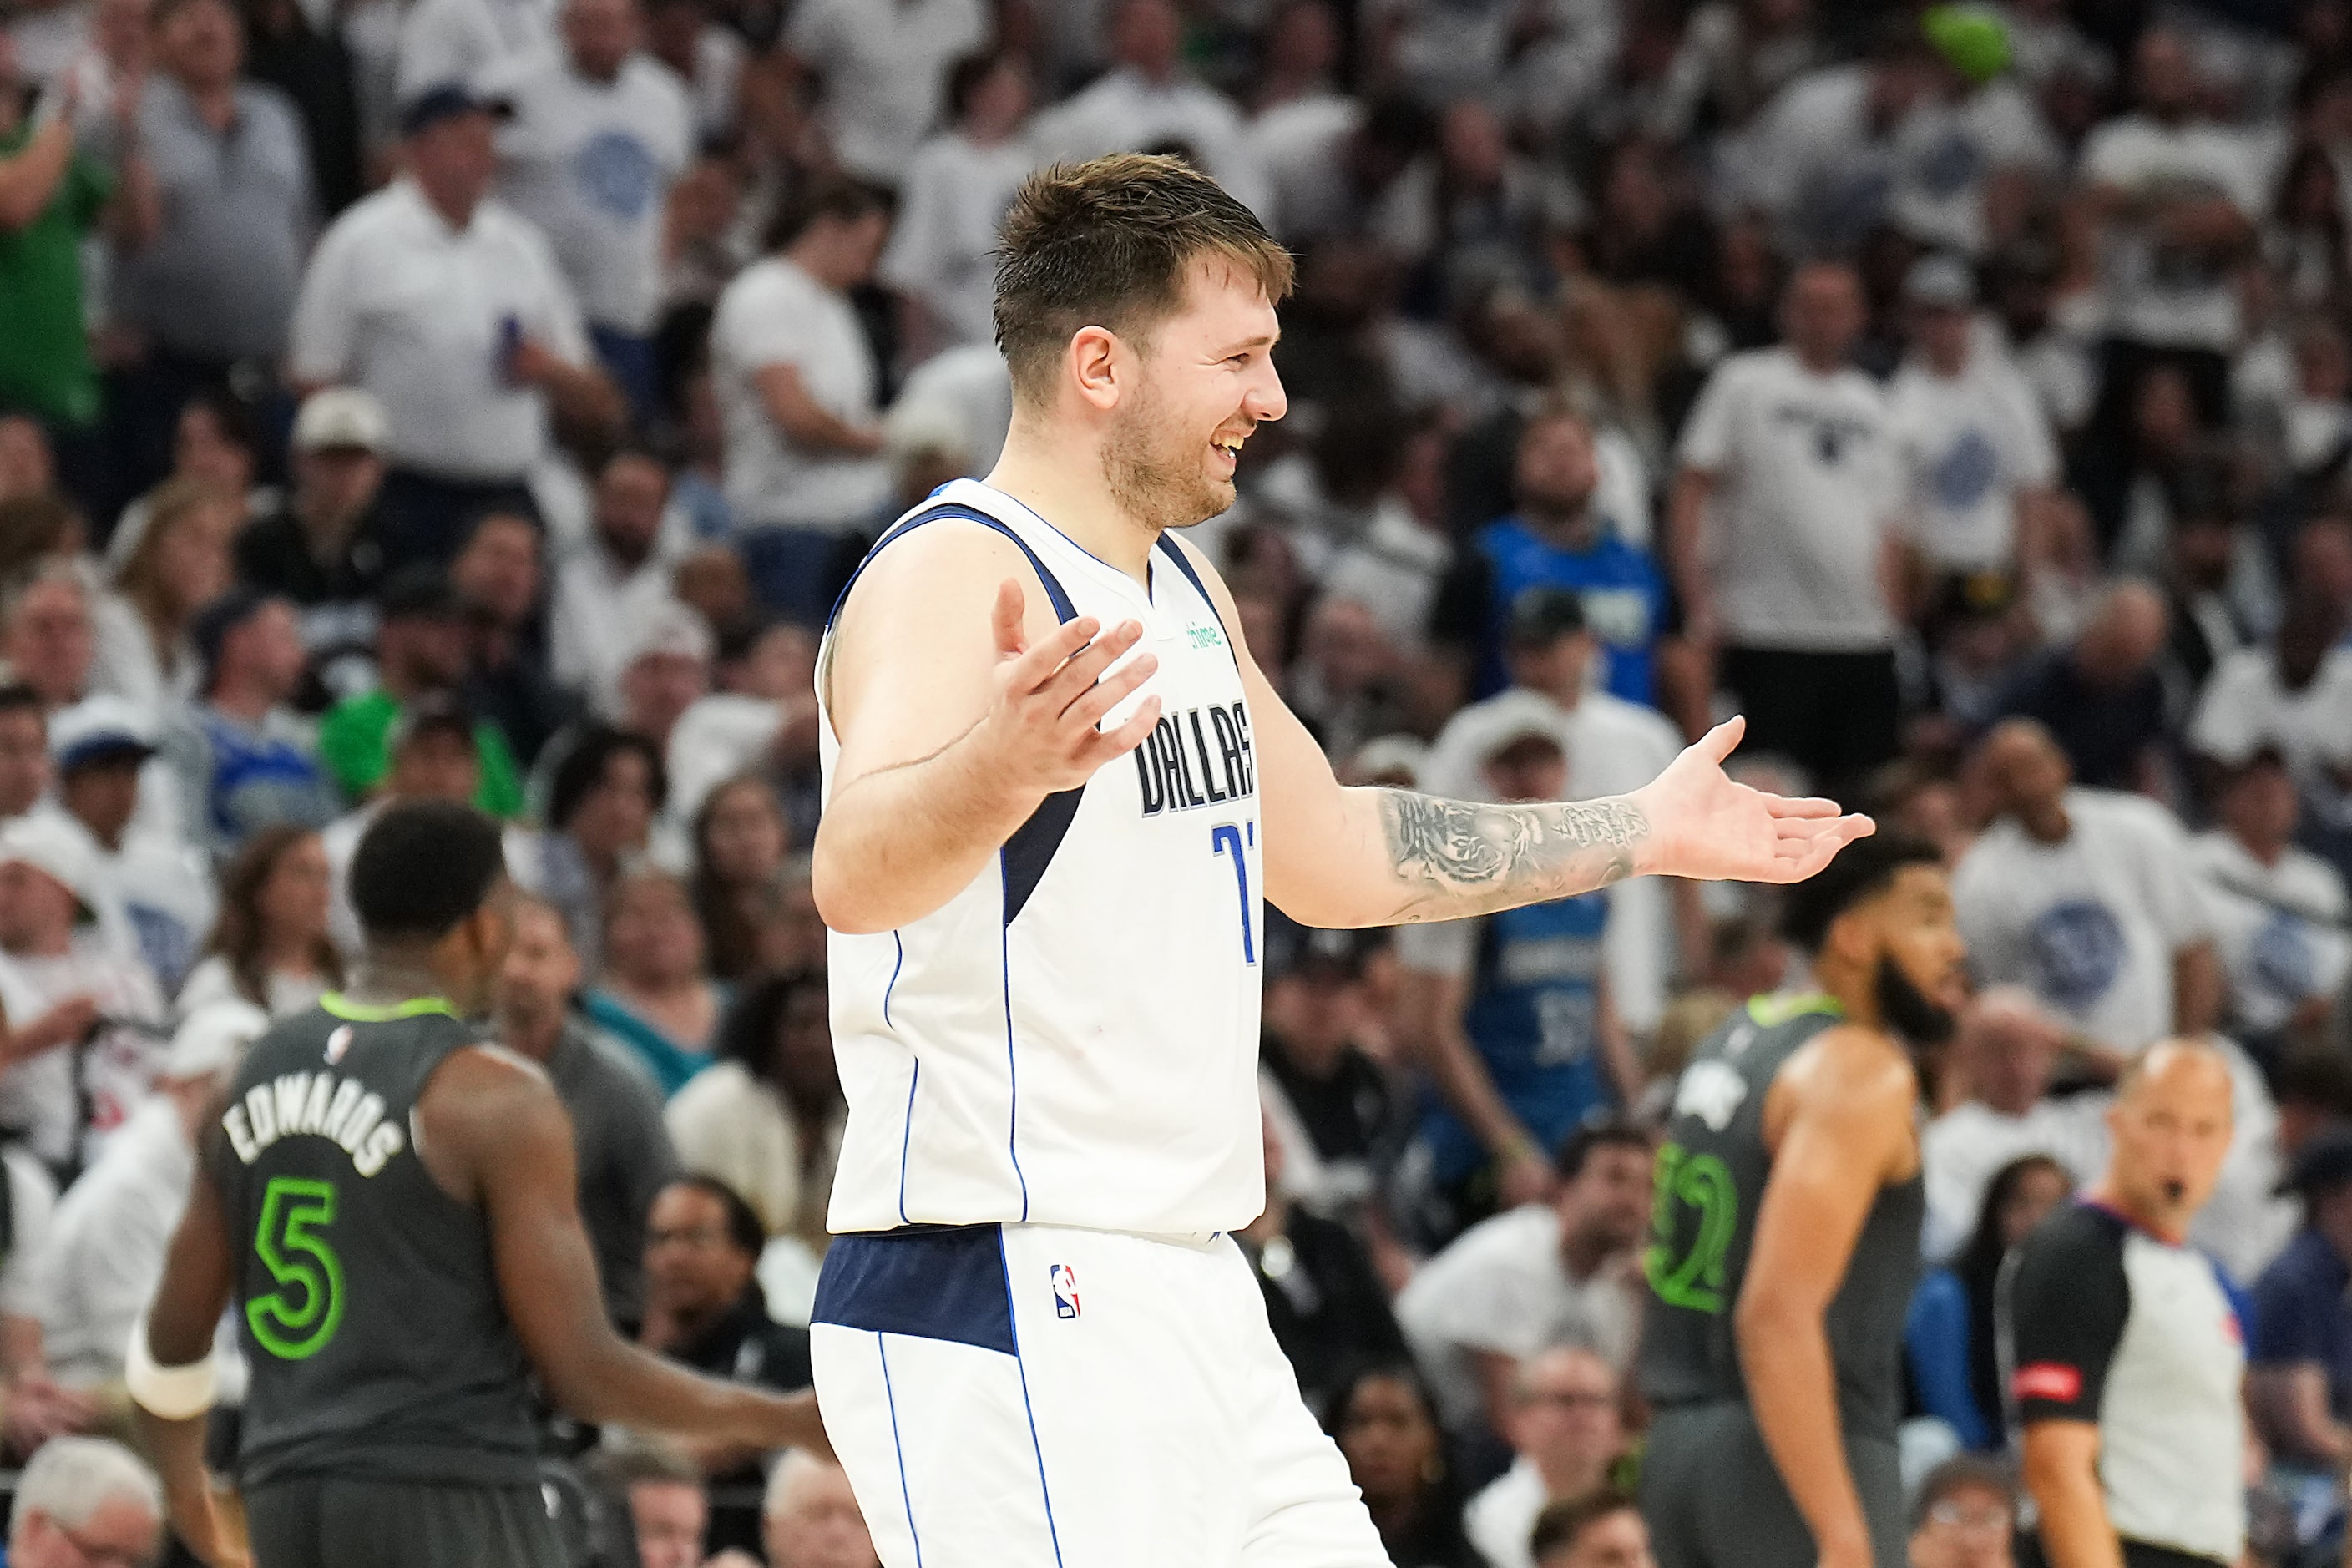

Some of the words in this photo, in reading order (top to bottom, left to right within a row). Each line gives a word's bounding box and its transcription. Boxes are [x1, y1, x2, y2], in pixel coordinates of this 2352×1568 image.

[1131, 698, 1253, 818] DALLAS
[1211, 818, 1257, 967] 7
[222, 1070, 404, 1178] EDWARDS
[245, 1176, 346, 1361] 5
